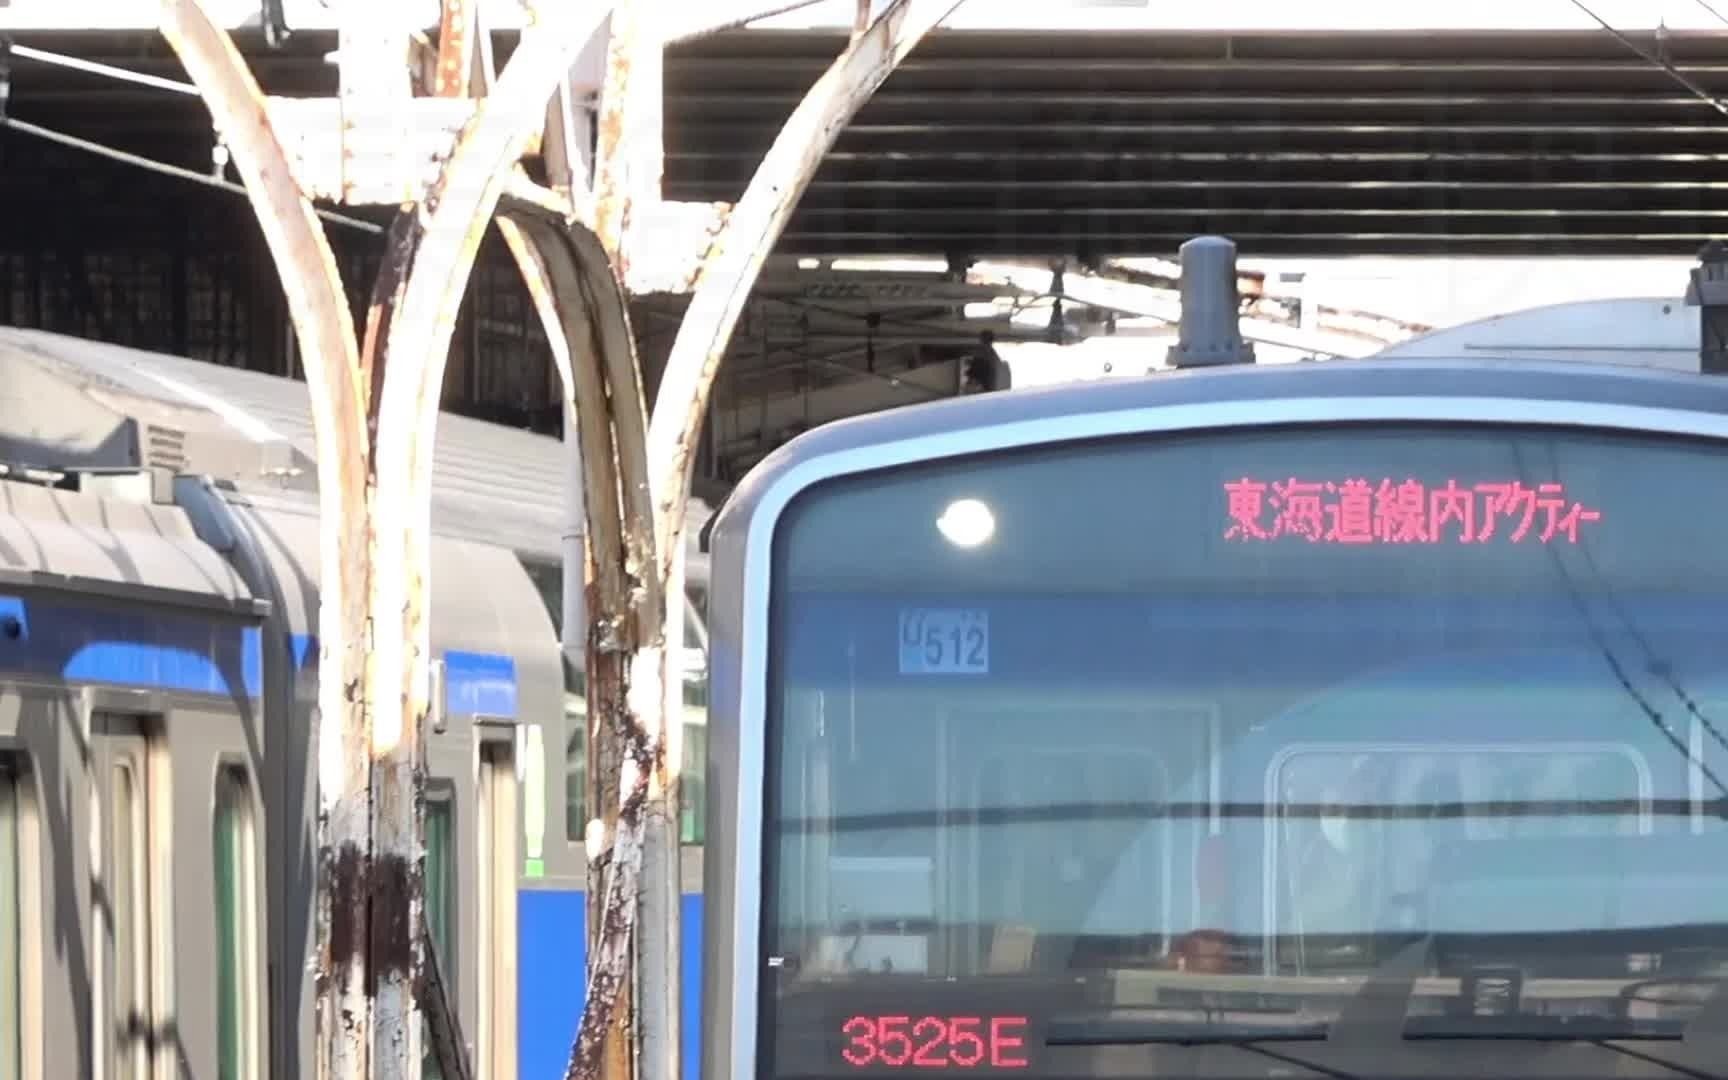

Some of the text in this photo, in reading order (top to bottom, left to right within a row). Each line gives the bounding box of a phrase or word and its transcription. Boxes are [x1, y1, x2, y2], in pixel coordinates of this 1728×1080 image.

[1223, 477, 1601, 544] 東海道線内アクティー
[841, 1015, 1029, 1067] 3525E
